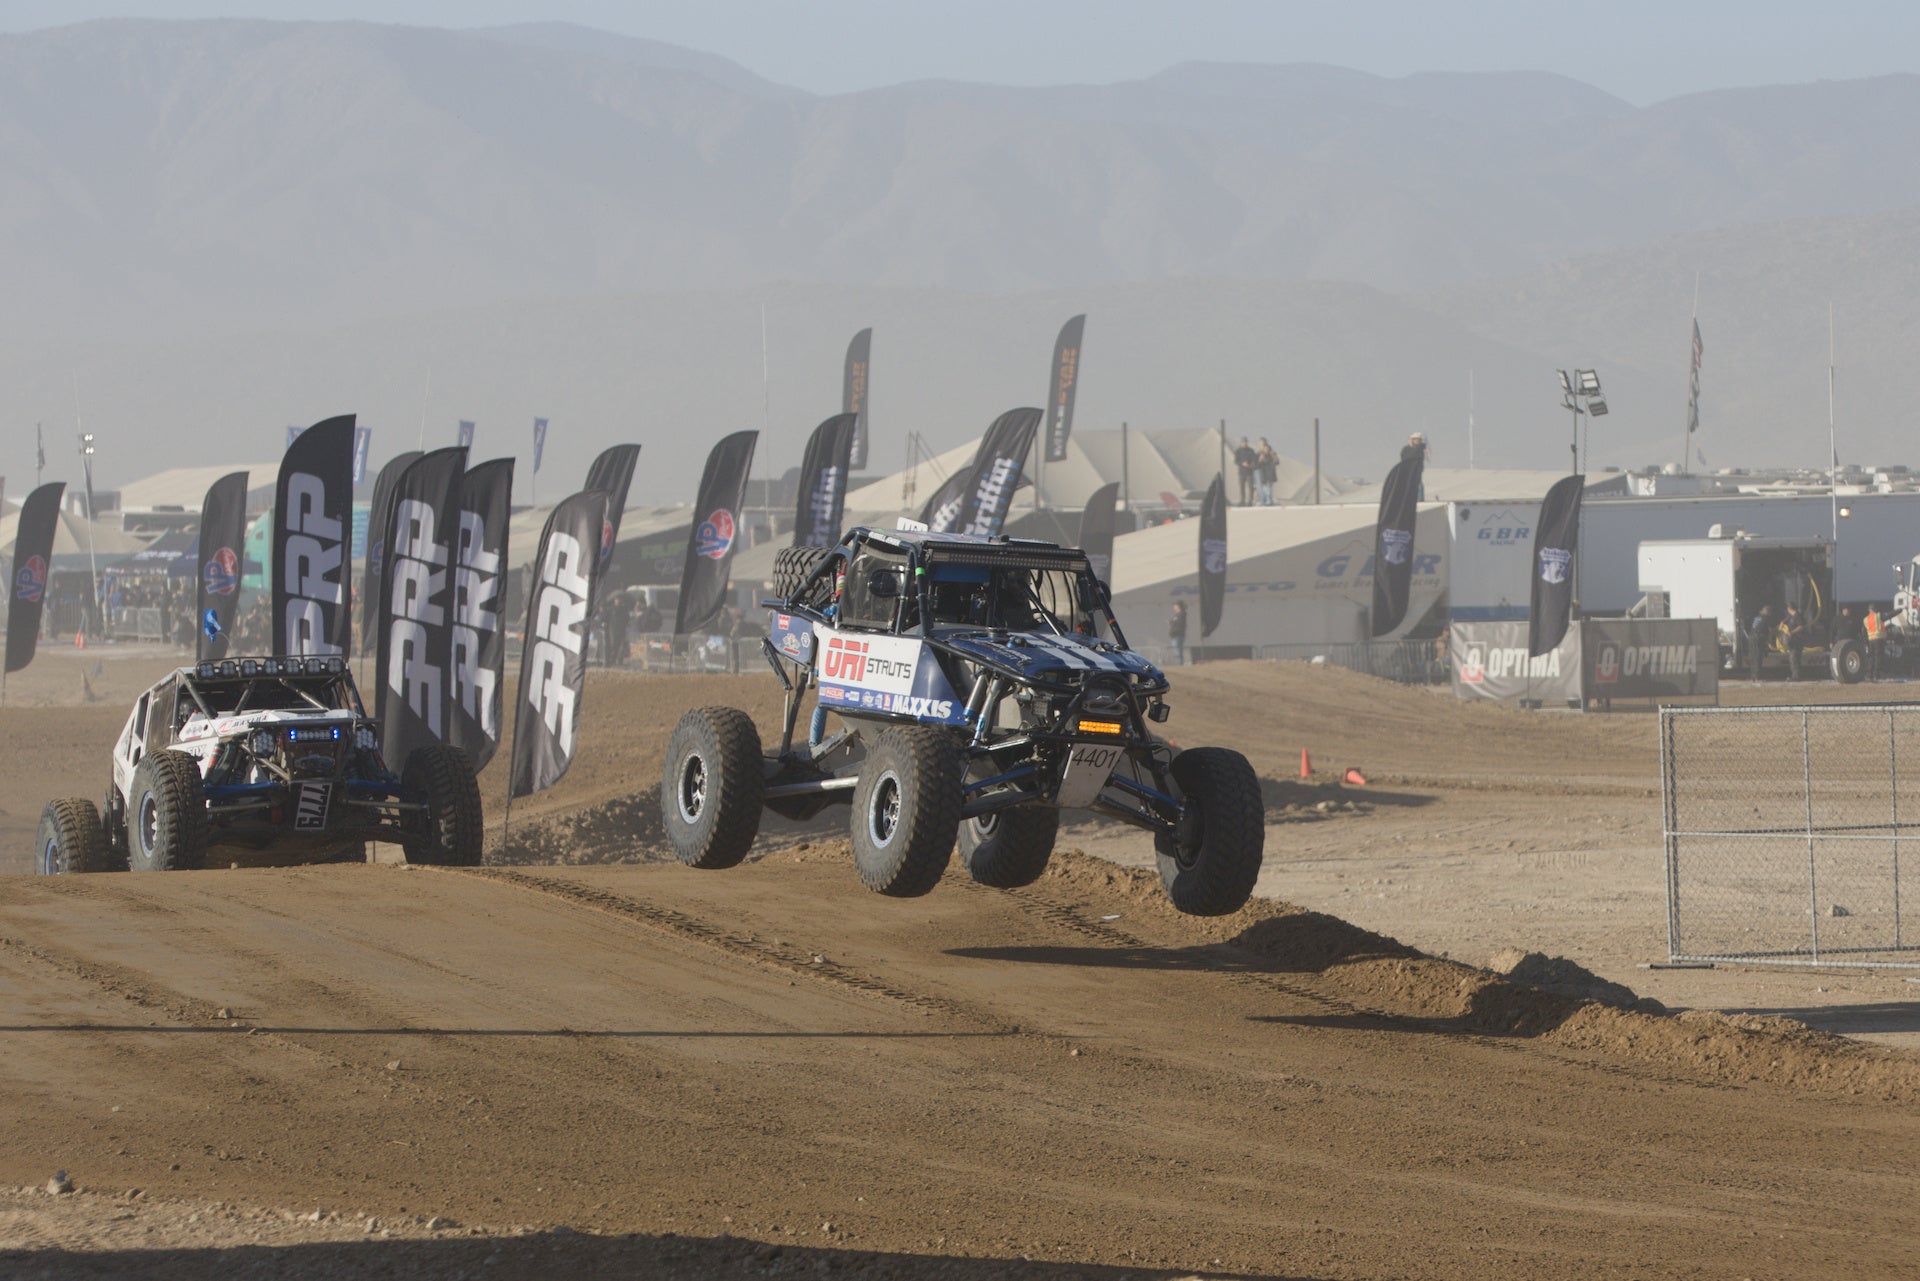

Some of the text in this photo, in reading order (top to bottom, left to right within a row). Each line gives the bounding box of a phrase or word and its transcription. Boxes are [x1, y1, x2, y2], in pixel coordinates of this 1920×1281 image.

[389, 499, 448, 740] PRP
[450, 510, 499, 741] PRP
[529, 532, 588, 758] PRP
[866, 657, 911, 679] STRUTS
[1488, 648, 1560, 678] OPTIMA
[1623, 645, 1697, 676] OPTIMA
[892, 694, 953, 719] MAXXIS
[1072, 748, 1117, 769] 4401
